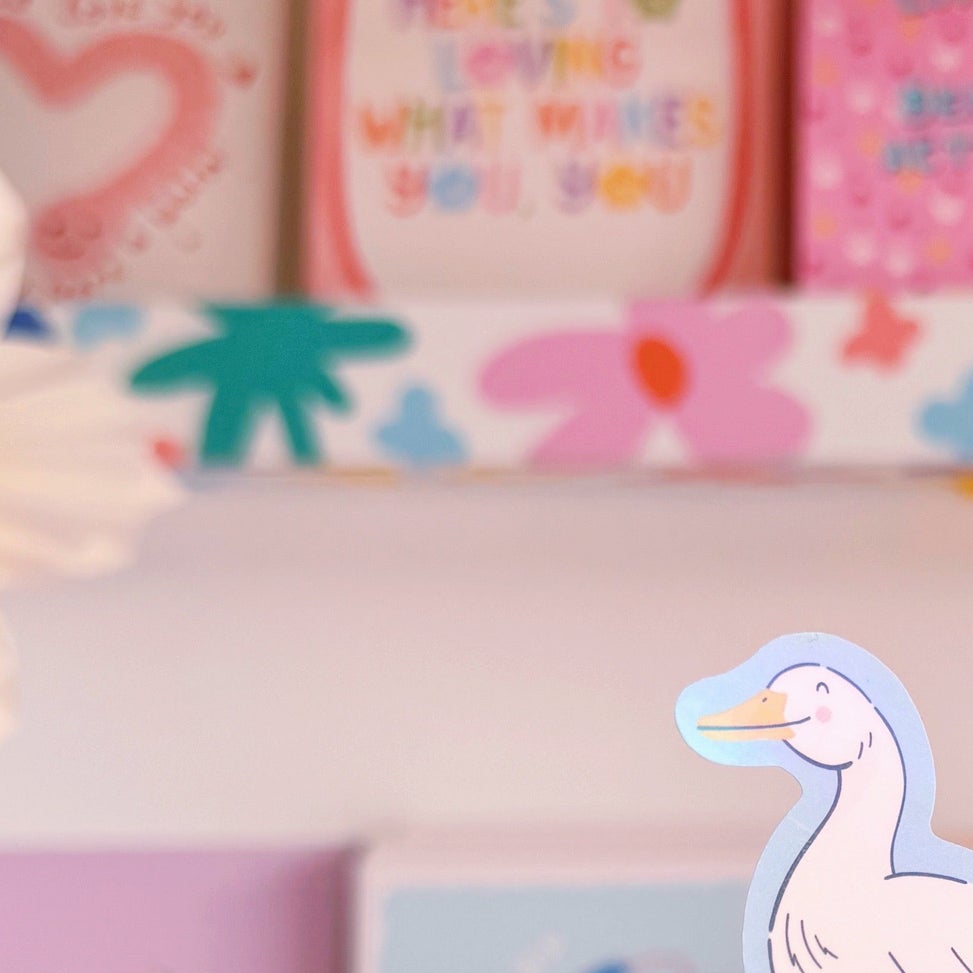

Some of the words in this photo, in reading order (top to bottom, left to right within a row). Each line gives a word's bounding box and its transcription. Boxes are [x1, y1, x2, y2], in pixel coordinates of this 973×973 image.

[434, 38, 641, 90] LOVING
[359, 96, 505, 151] WHAT
[535, 94, 721, 150] MAKES
[555, 157, 695, 215] YOU
